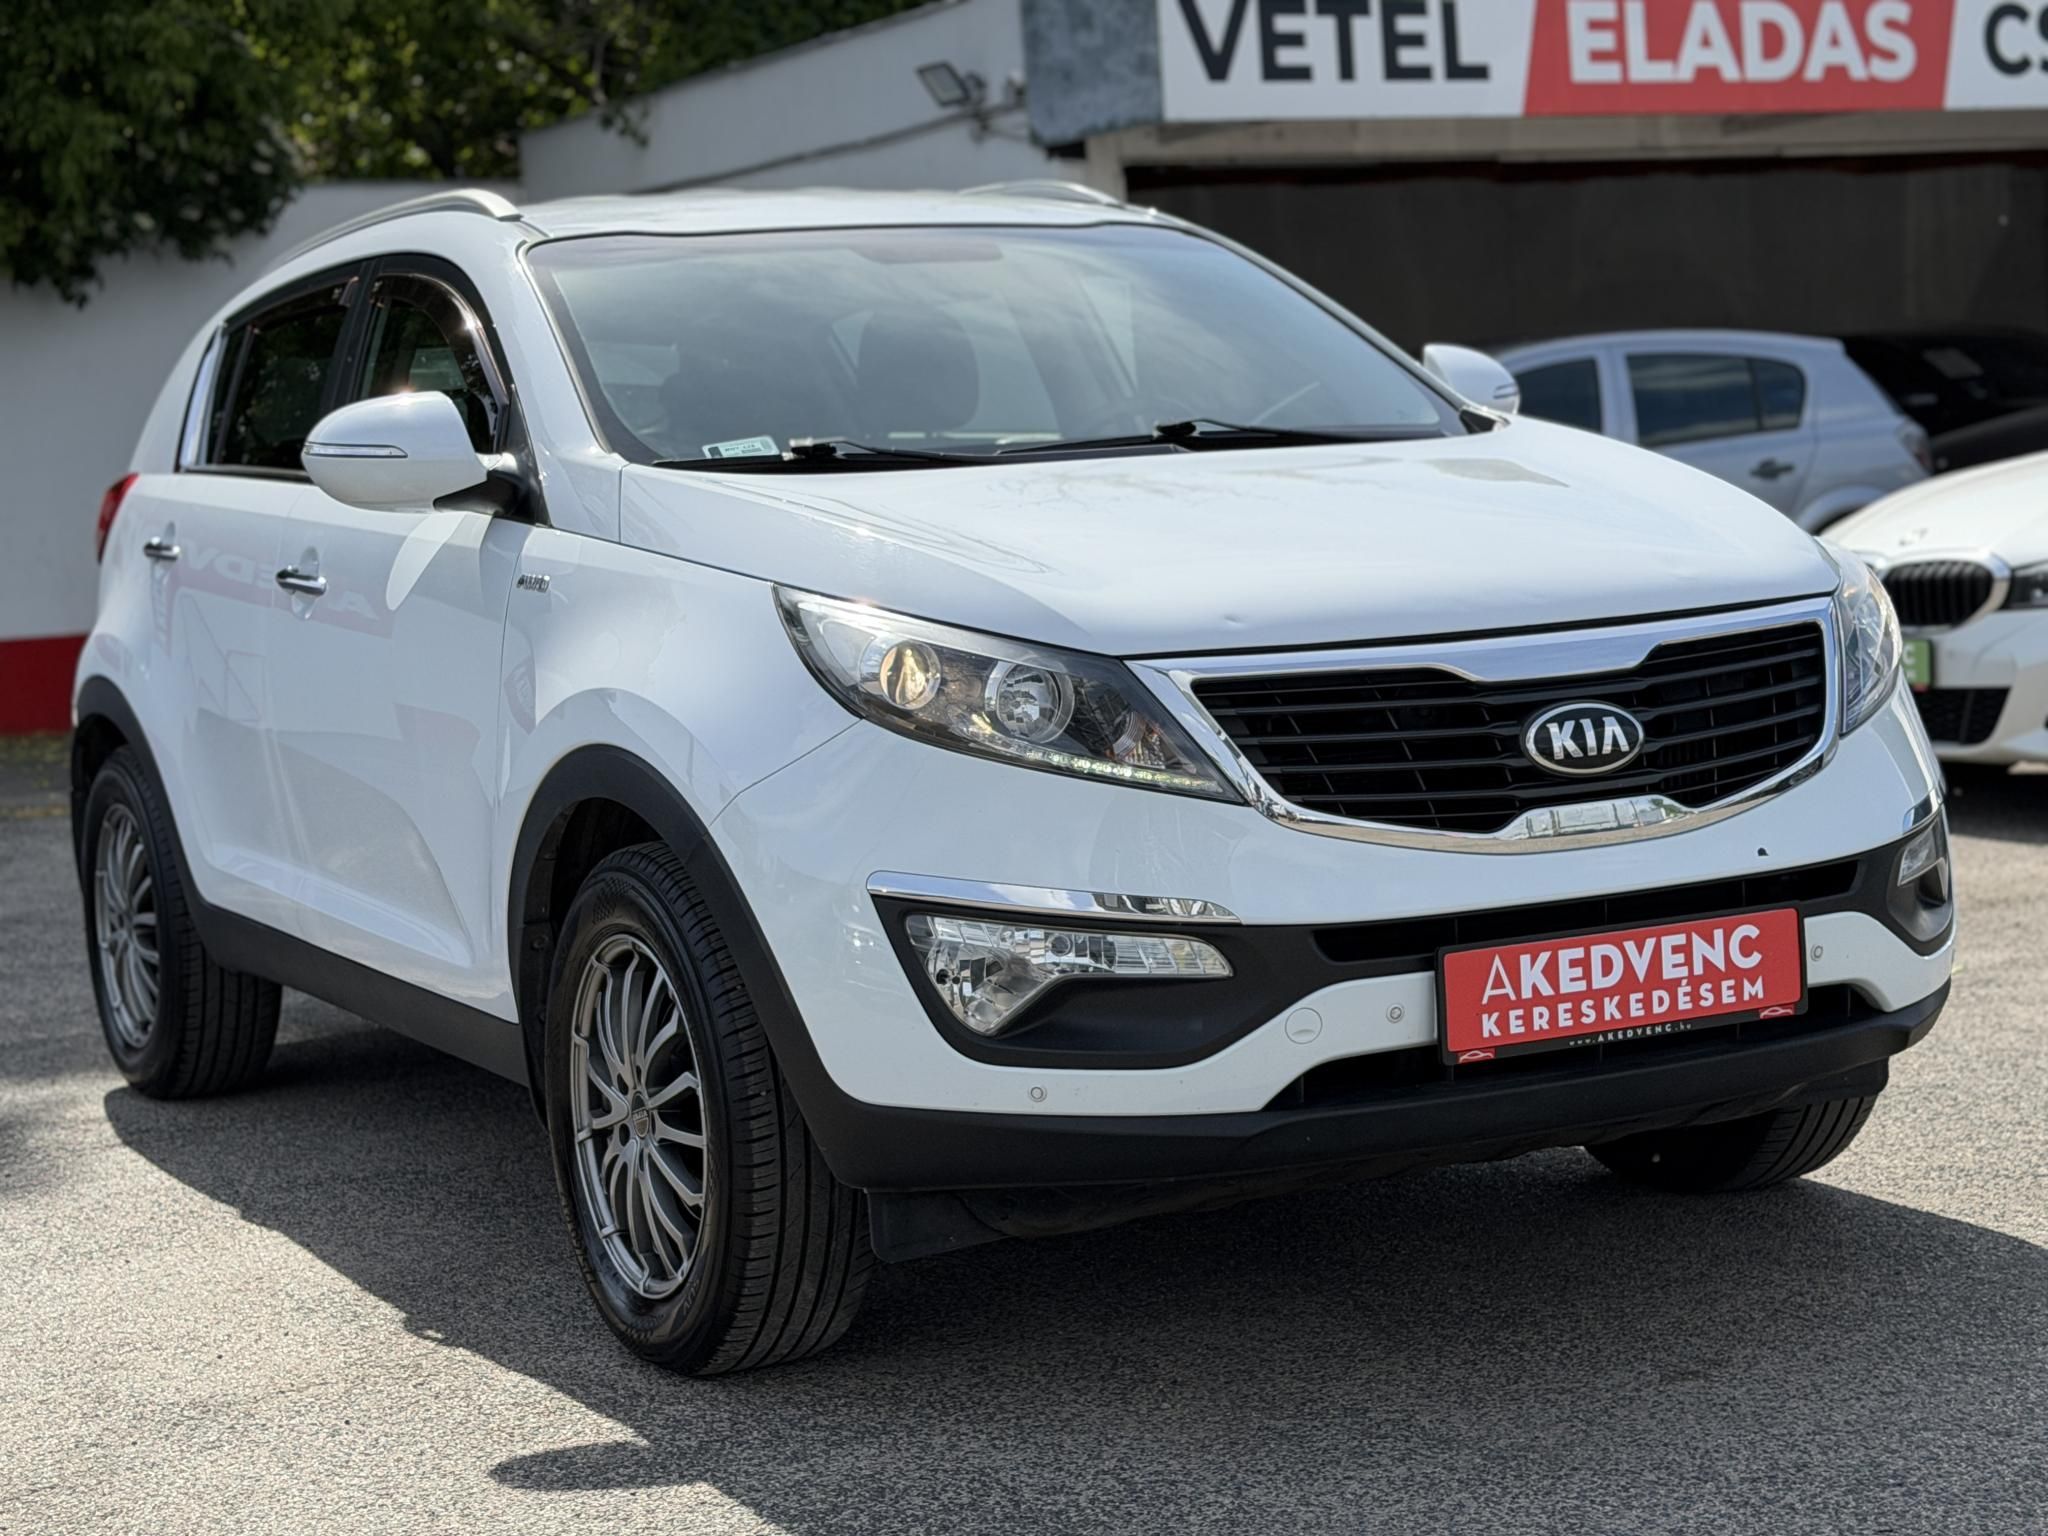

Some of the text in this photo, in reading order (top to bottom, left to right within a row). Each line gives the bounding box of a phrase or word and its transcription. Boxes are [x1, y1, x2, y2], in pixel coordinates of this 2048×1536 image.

[1984, 3, 2048, 76] C
[1546, 716, 1630, 760] KIA
[1481, 924, 1763, 1006] AKEDVENC
[1481, 975, 1765, 1039] KERESKEDÉSEM
